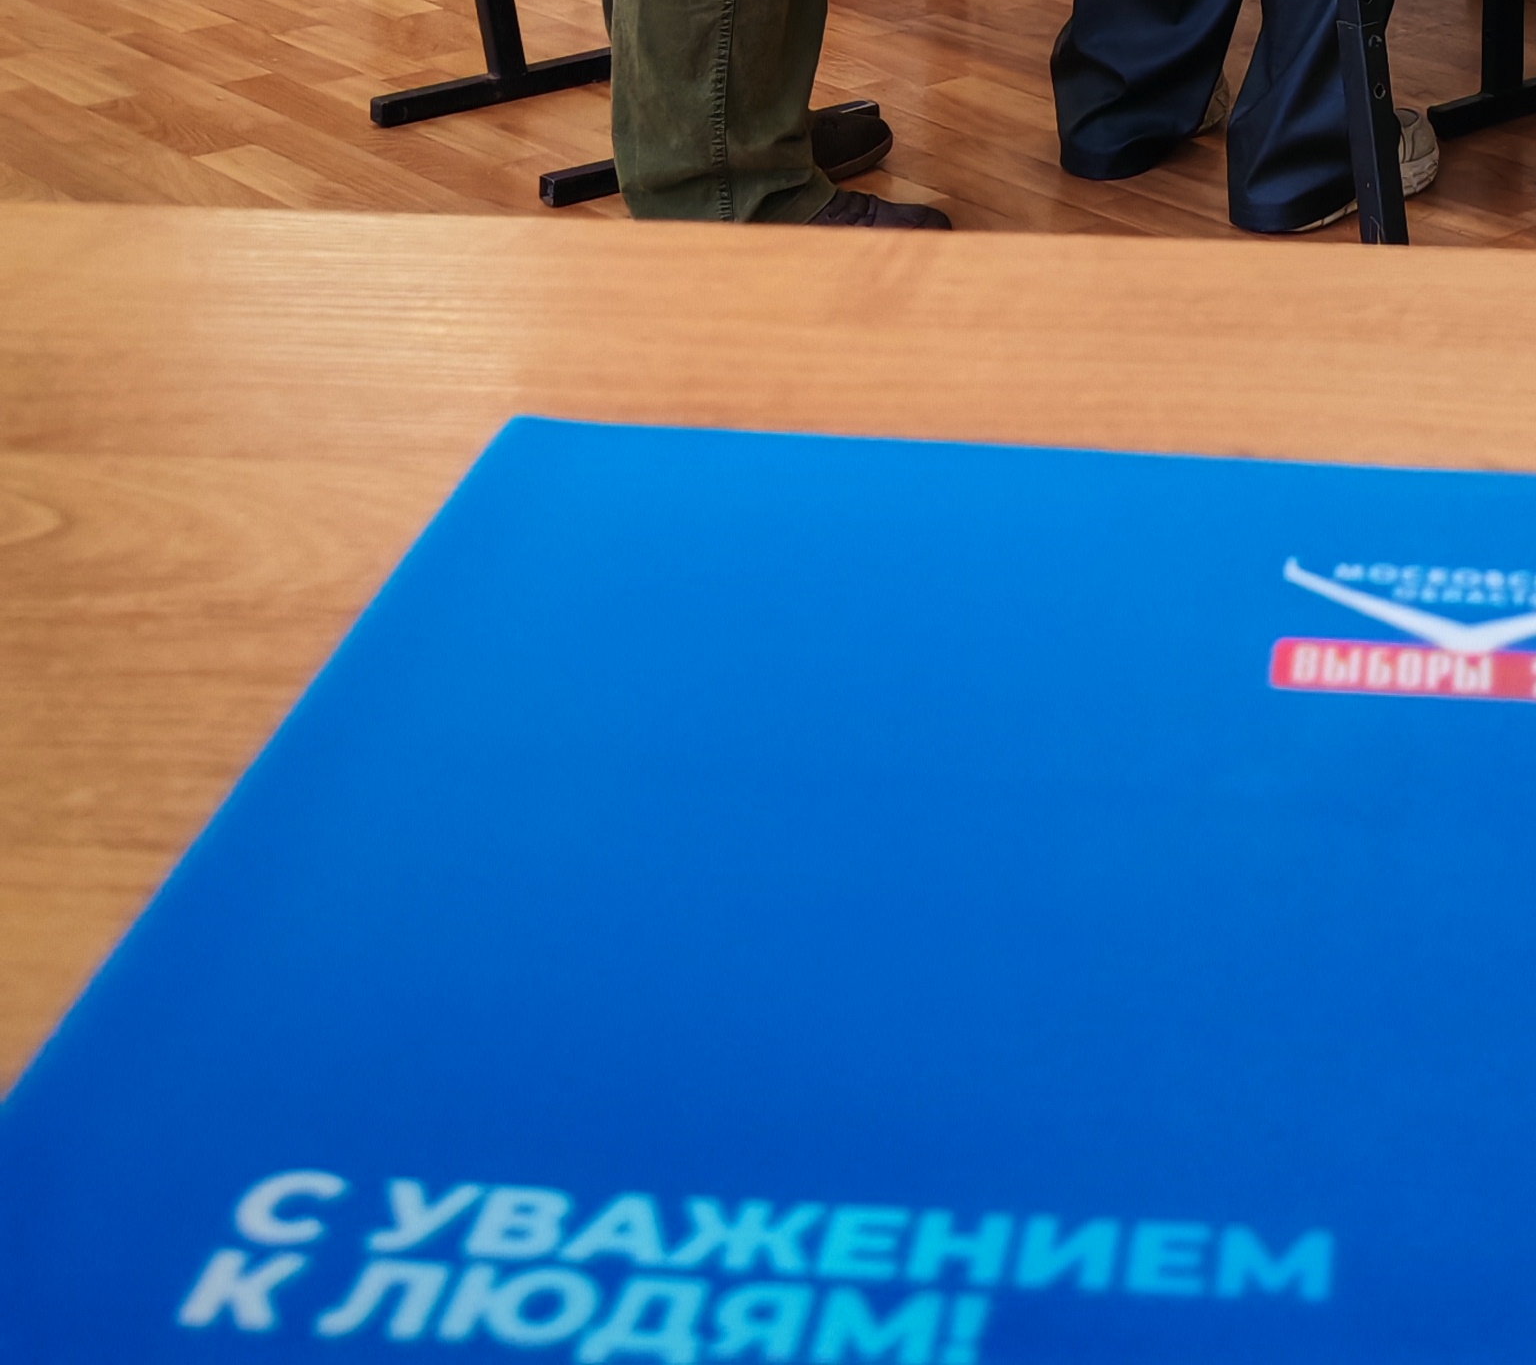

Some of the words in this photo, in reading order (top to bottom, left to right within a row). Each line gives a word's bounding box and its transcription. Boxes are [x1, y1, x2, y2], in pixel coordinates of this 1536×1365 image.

[1292, 643, 1493, 695] ВЫБОРЫ
[233, 1169, 349, 1246] С
[366, 1177, 1334, 1303] УВАЖЕНИЕМ
[177, 1247, 307, 1332] К
[315, 1257, 992, 1365] ЛЮДЯМ!
